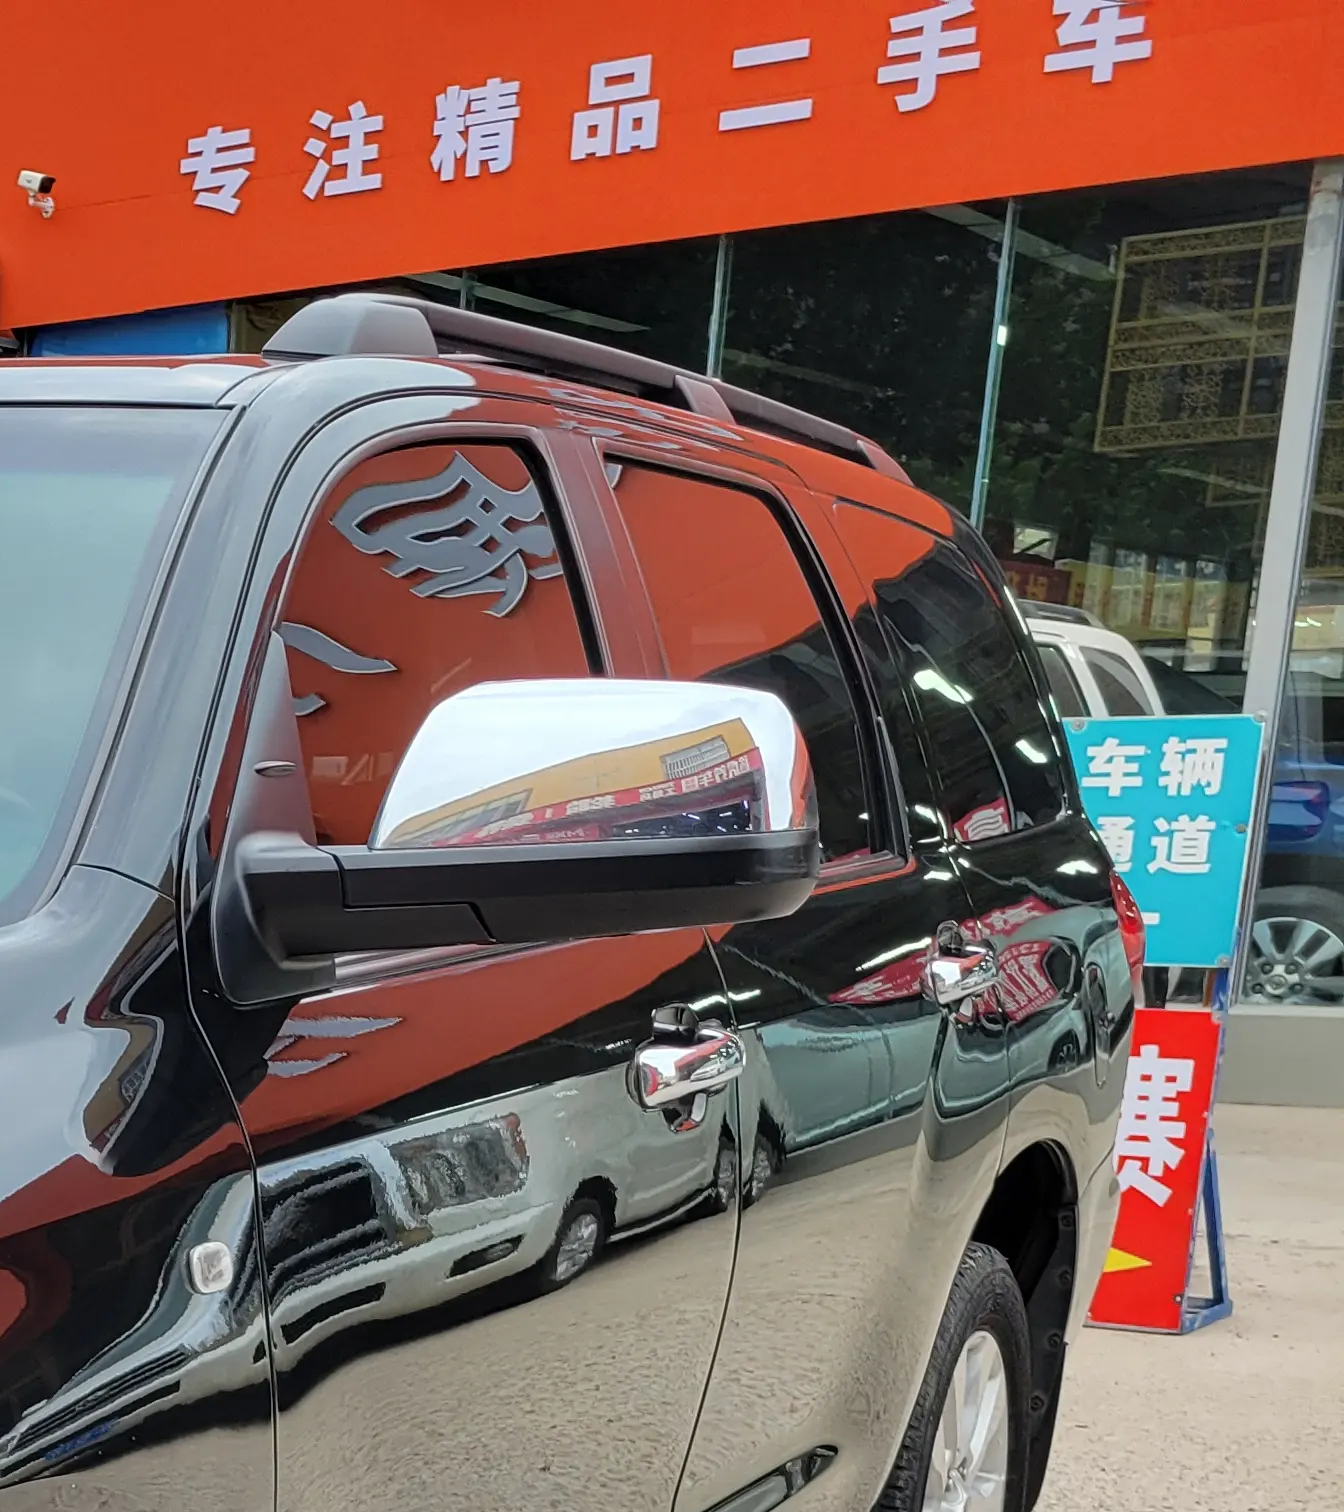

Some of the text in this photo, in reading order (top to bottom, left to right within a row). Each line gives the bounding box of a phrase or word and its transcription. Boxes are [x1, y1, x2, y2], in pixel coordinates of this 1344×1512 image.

[178, 0, 1154, 215] 专注精品二手车
[1081, 736, 1228, 797] 车辆
[1096, 814, 1217, 874] 通道
